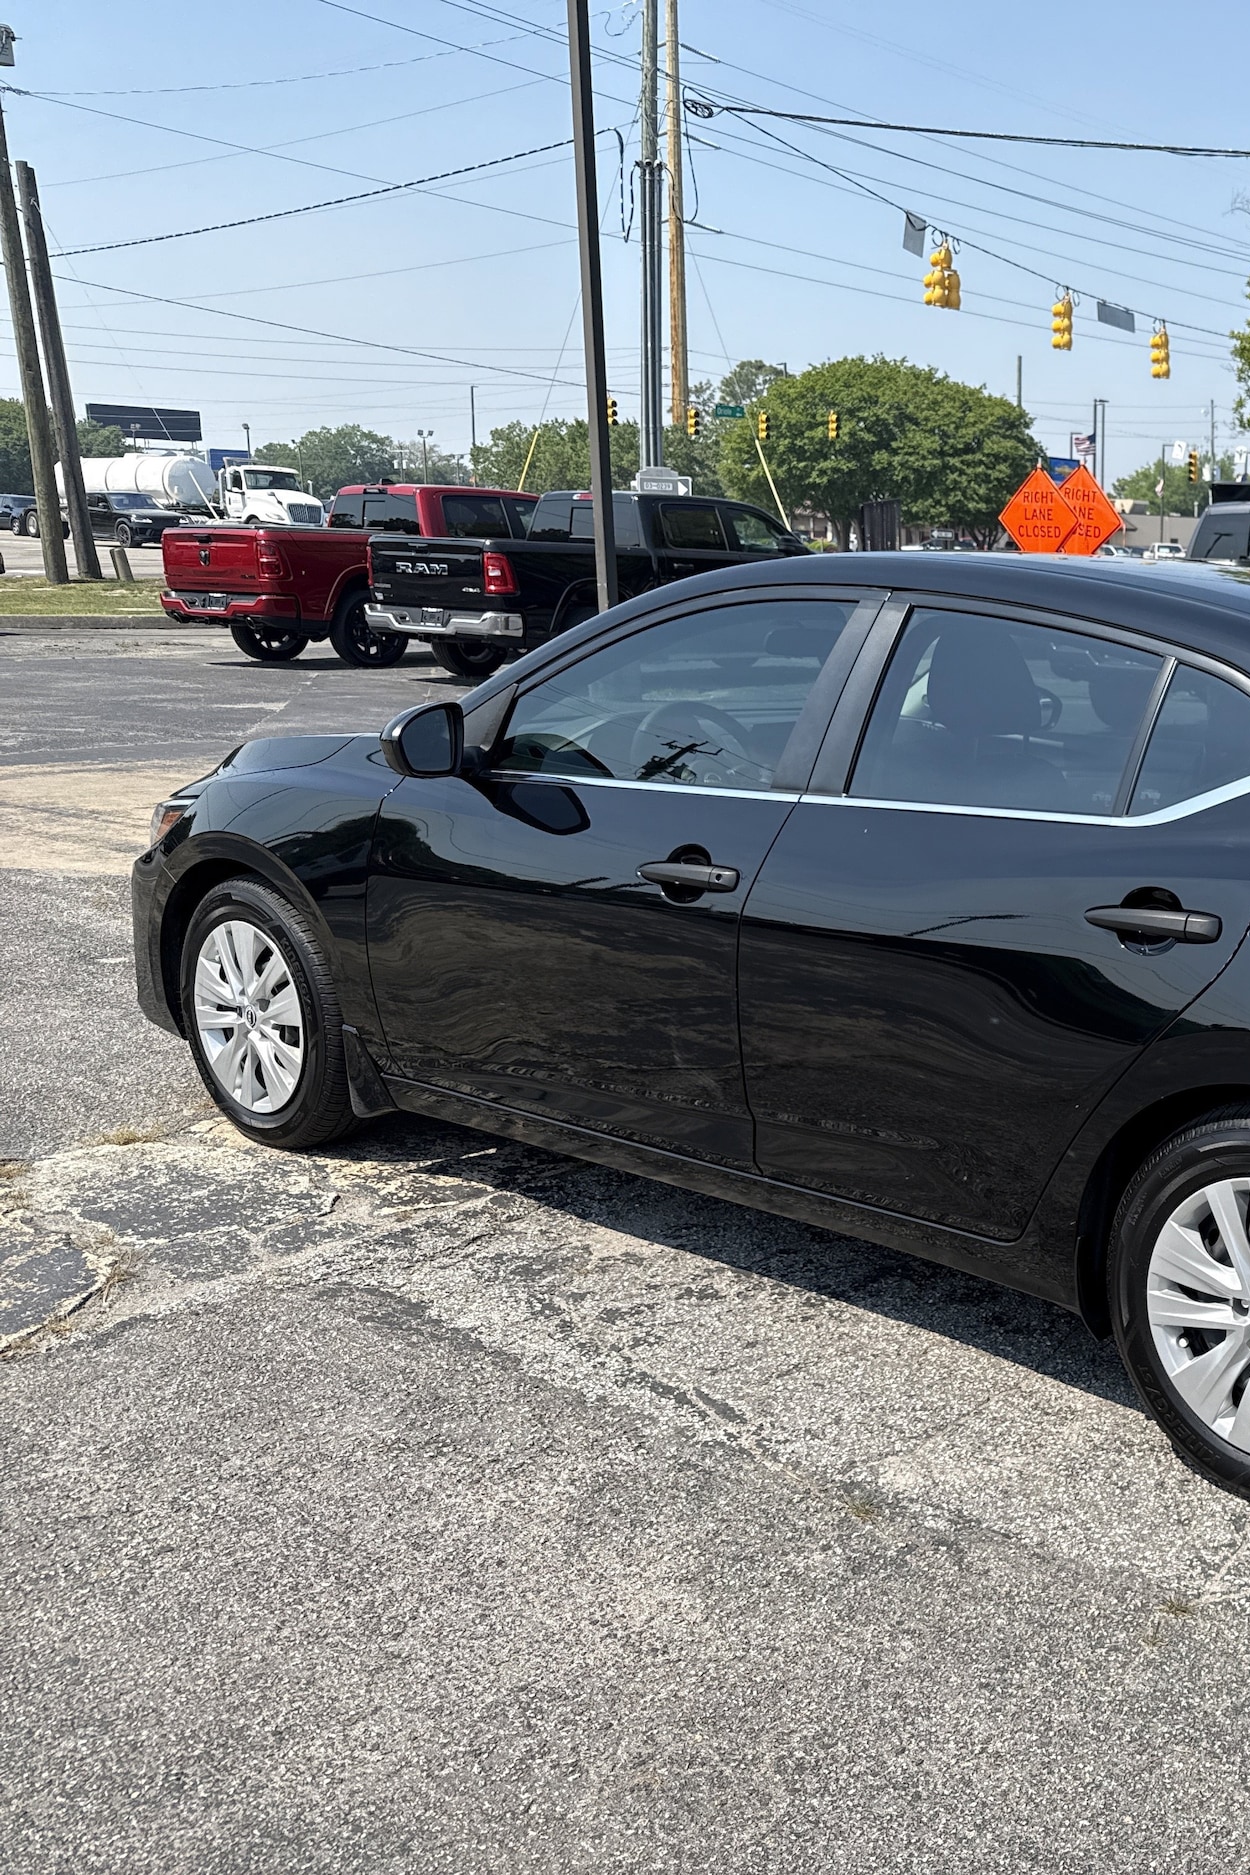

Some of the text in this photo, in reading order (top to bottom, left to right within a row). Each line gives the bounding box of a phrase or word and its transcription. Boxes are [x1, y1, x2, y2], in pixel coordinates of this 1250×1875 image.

[1023, 491, 1055, 504] RIGHT
[1064, 487, 1097, 503] RIGHT
[1024, 508, 1053, 521] LANE
[1018, 525, 1061, 538] CLOSED
[395, 562, 448, 575] RAM
